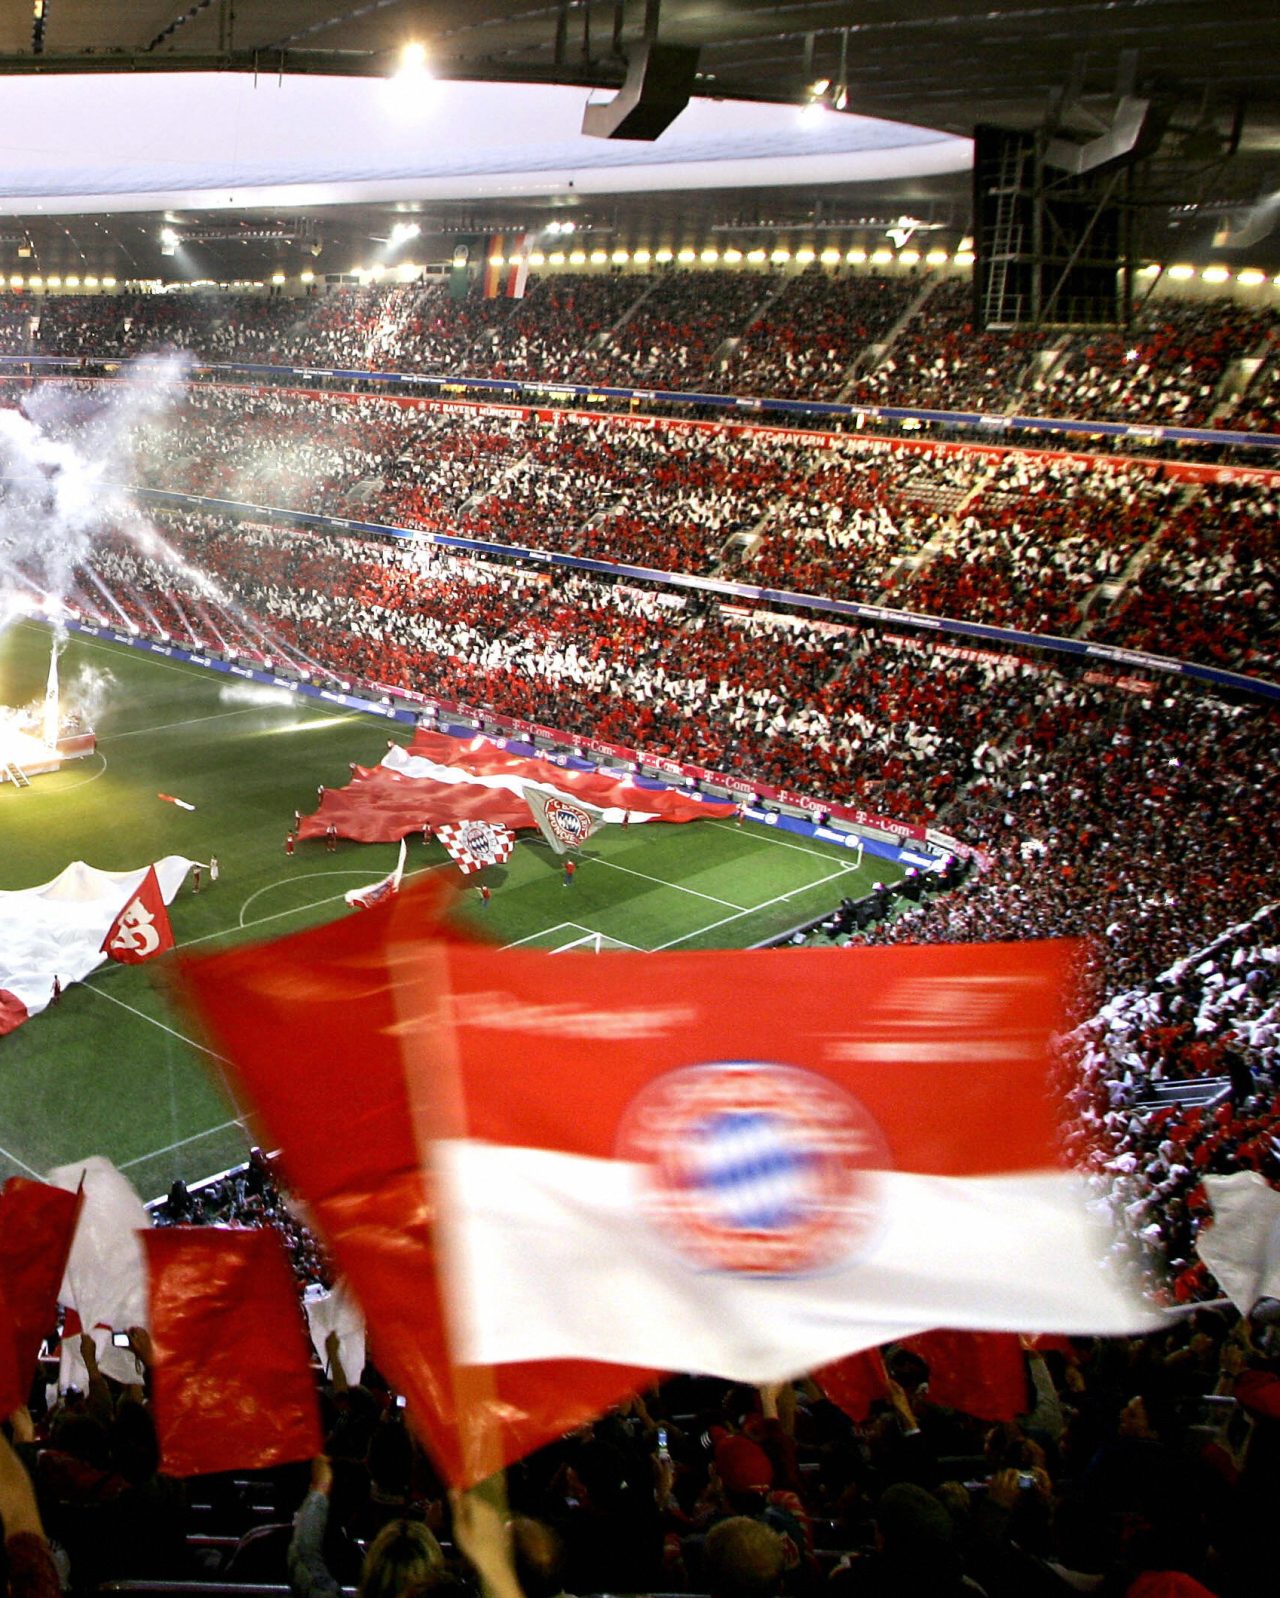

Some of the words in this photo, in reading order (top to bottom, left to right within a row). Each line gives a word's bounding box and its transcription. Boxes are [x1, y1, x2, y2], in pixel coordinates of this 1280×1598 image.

[429, 403, 441, 411] FC
[442, 404, 477, 414] BAYERN
[479, 405, 523, 418] MÜNCHEN
